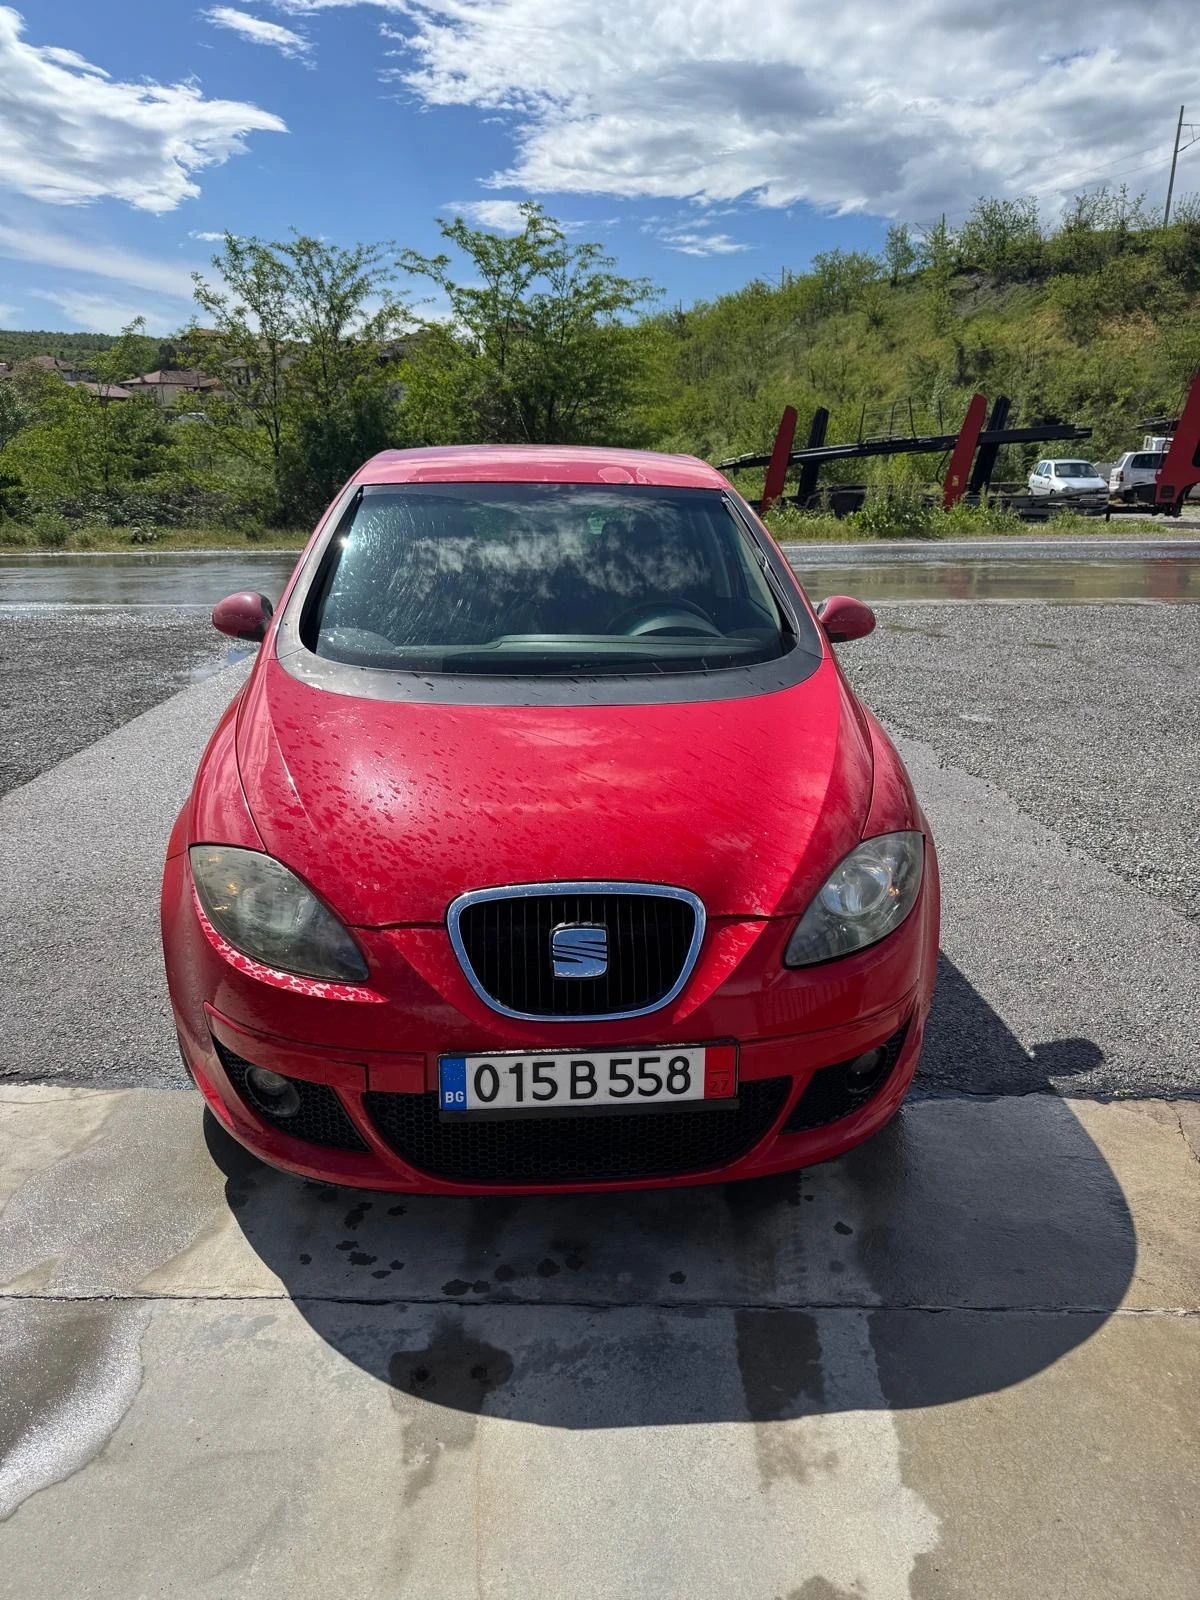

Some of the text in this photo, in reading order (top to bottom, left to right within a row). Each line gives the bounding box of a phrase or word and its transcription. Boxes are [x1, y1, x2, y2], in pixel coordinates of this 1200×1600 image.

[473, 1062, 558, 1103] 015
[609, 1056, 691, 1098] 558
[445, 1091, 464, 1103] BG
